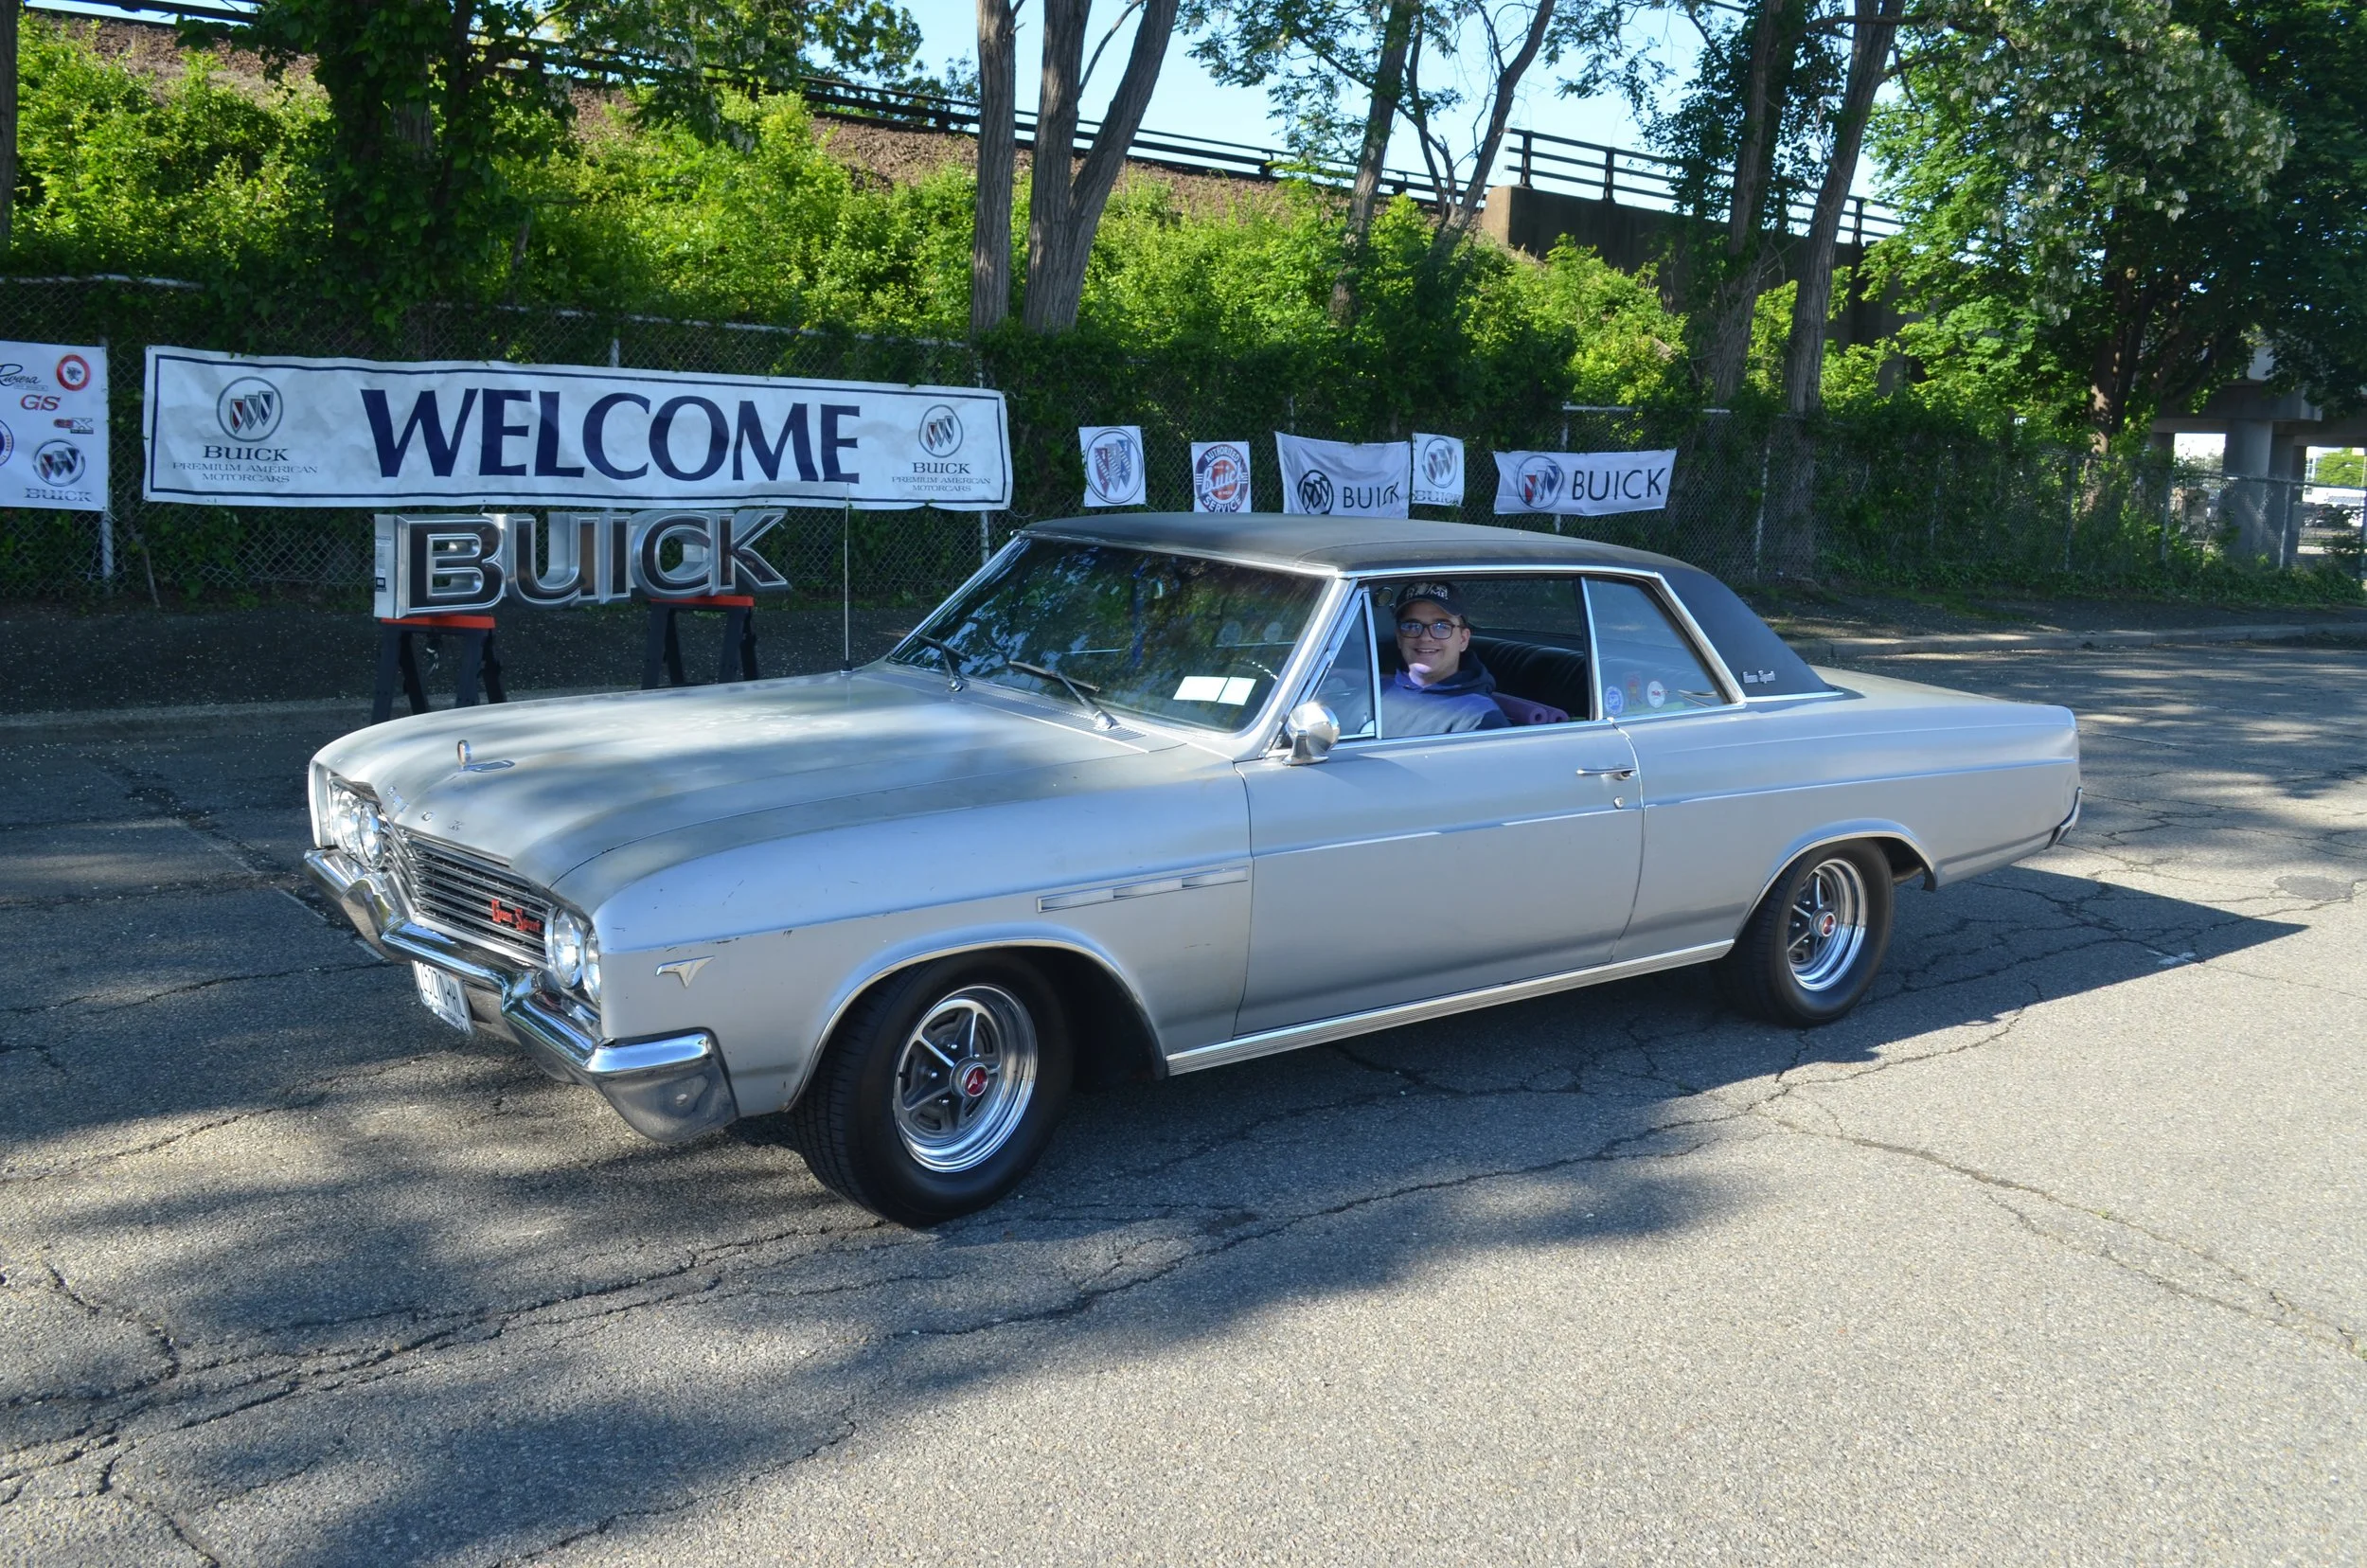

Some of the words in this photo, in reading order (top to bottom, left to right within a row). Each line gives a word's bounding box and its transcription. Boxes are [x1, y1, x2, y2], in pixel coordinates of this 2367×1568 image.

[20, 394, 61, 412] GS
[361, 387, 861, 484] WELCOME
[203, 445, 289, 462] BUICK
[172, 462, 240, 472] PREMIUM
[245, 464, 317, 473] AMERICAN
[912, 461, 970, 474] BUICK
[202, 473, 290, 483] MOTORCARS
[940, 476, 991, 485] AMERICAN
[1201, 461, 1245, 494] Buick
[1572, 467, 1667, 502] BUICK
[24, 488, 92, 502] BUICK
[912, 484, 971, 492] MOTORCARS
[1202, 496, 1241, 512] SERVICE
[1413, 490, 1462, 506] BUICK
[390, 509, 792, 618] BUICK
